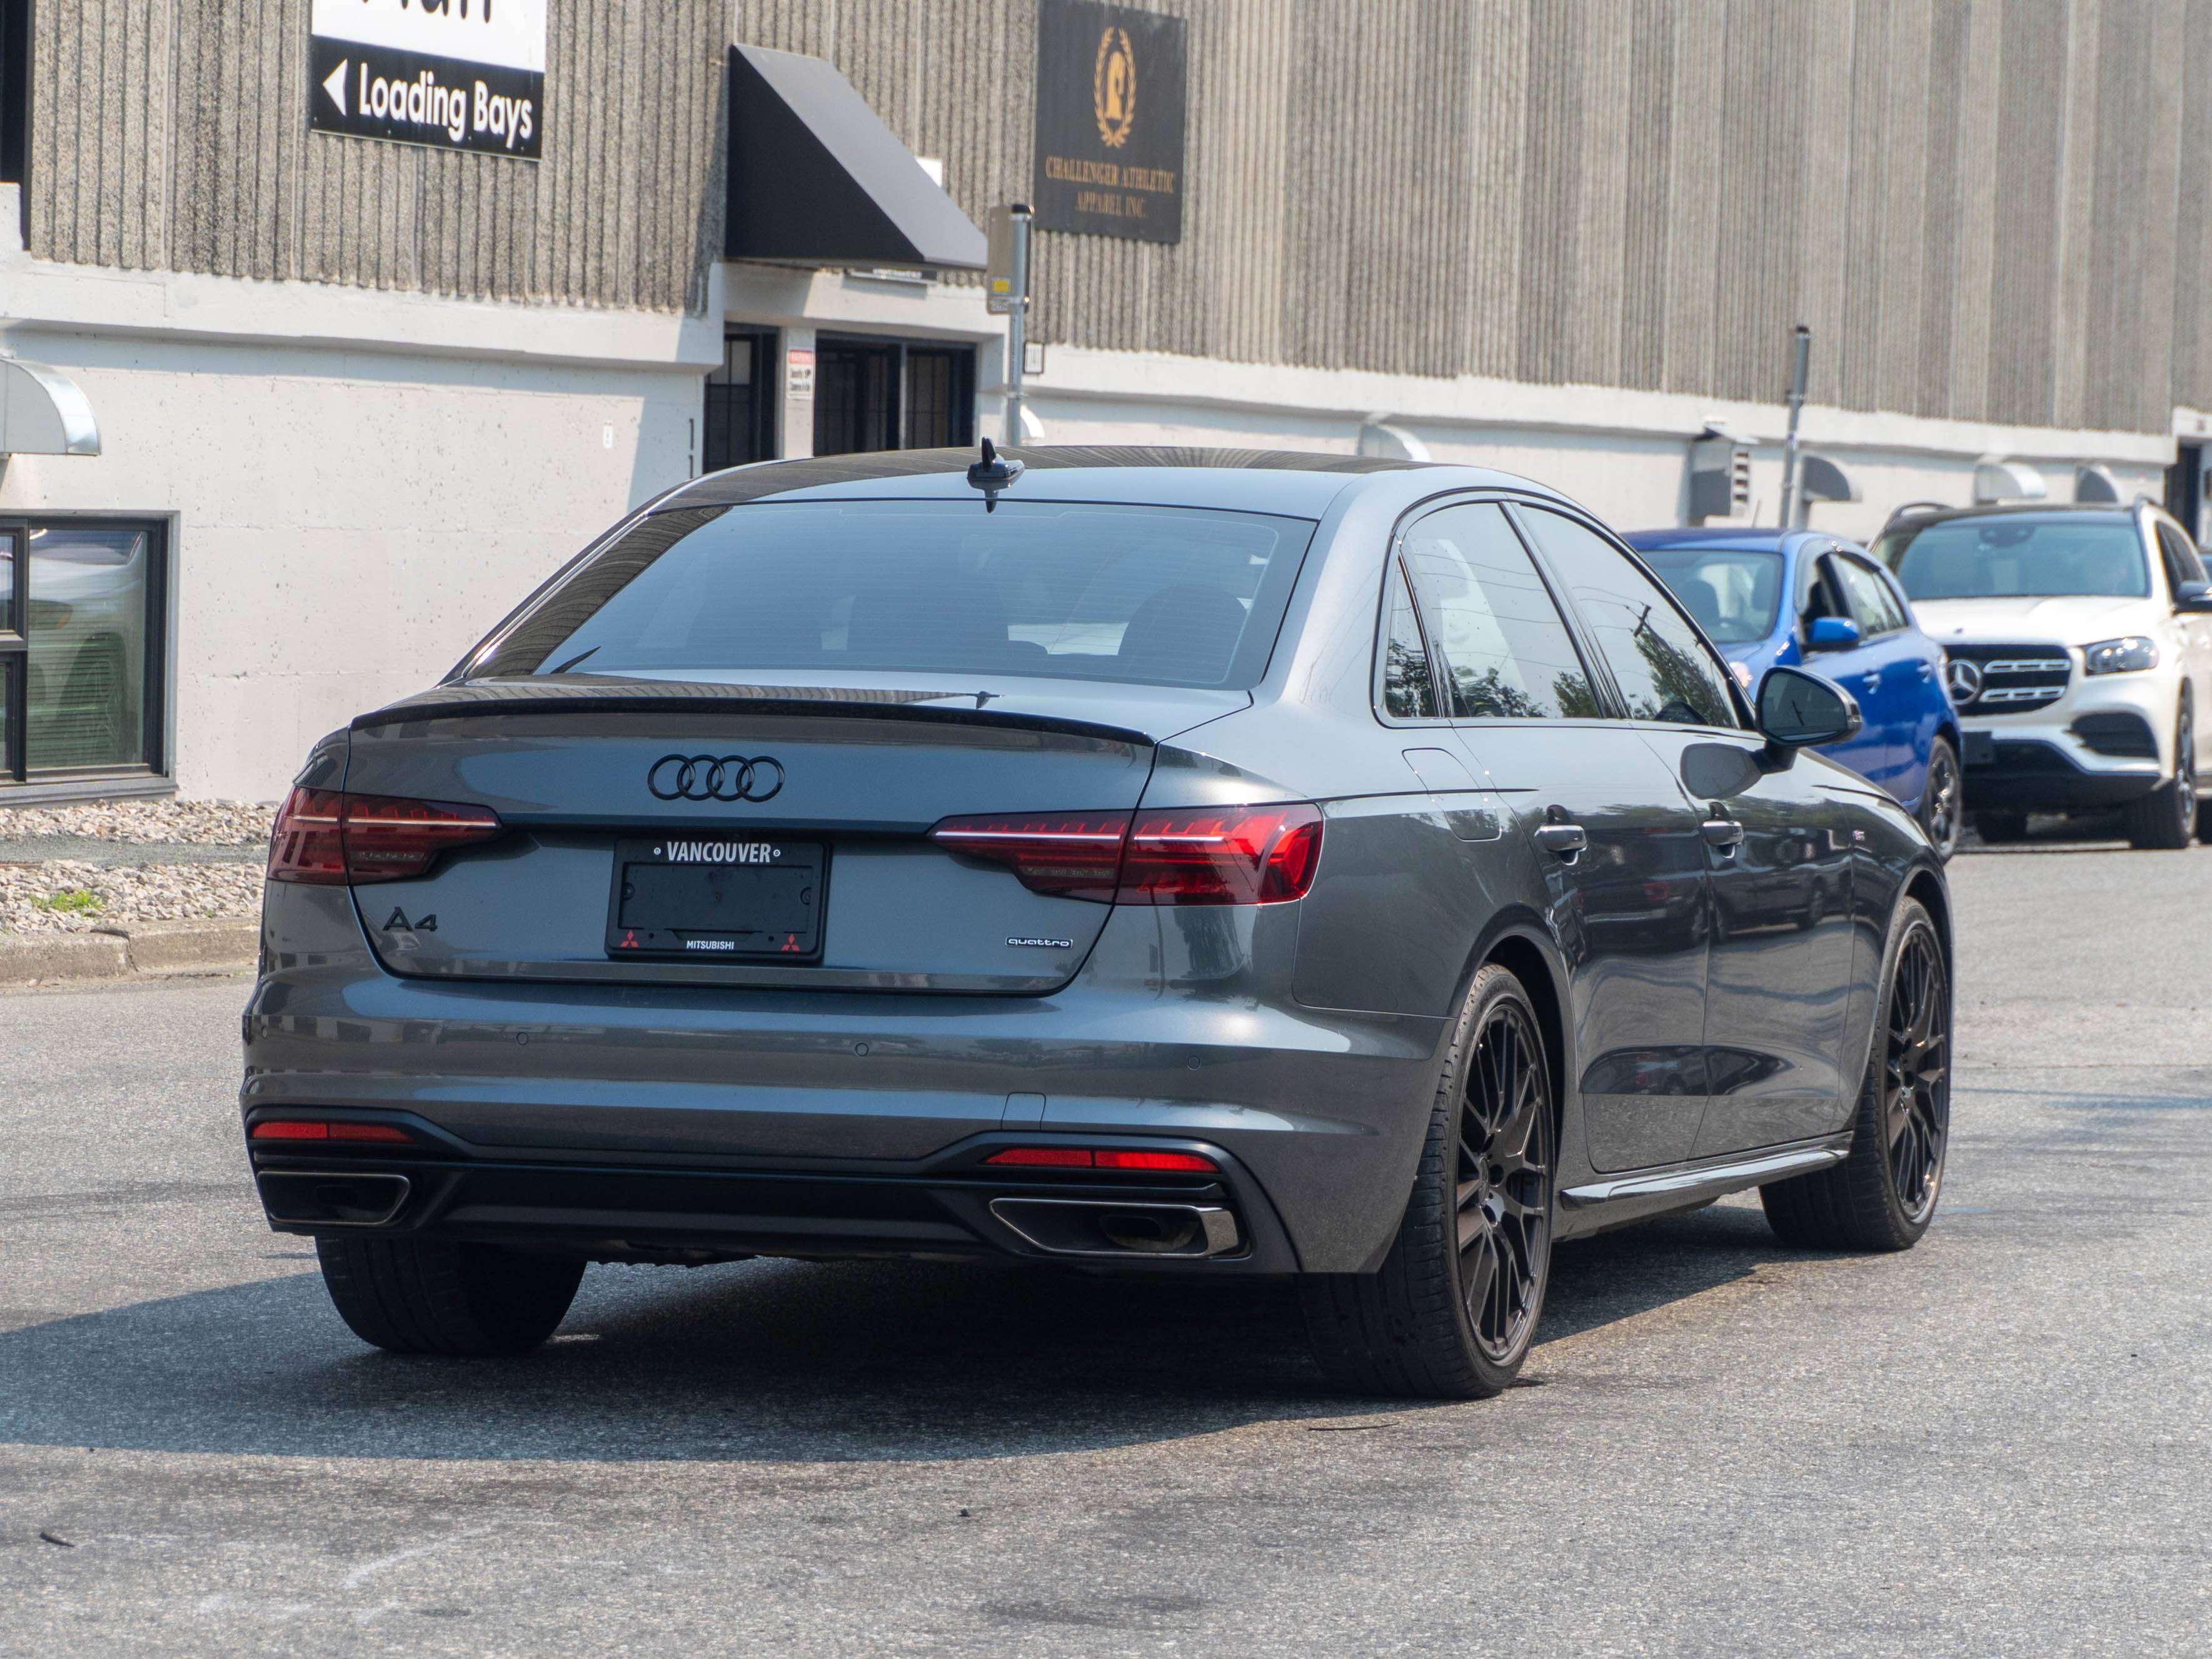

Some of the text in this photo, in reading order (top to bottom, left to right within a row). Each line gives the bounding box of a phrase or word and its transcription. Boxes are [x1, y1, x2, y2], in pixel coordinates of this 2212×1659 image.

[359, 62, 533, 149] Loading Bays
[1045, 156, 1175, 194] CHALLENGER ATHLETIC
[666, 841, 772, 863] VANCOUVER
[382, 906, 438, 931] A4
[686, 940, 735, 950] MITSUBISHI
[1008, 938, 1069, 946] quattro
